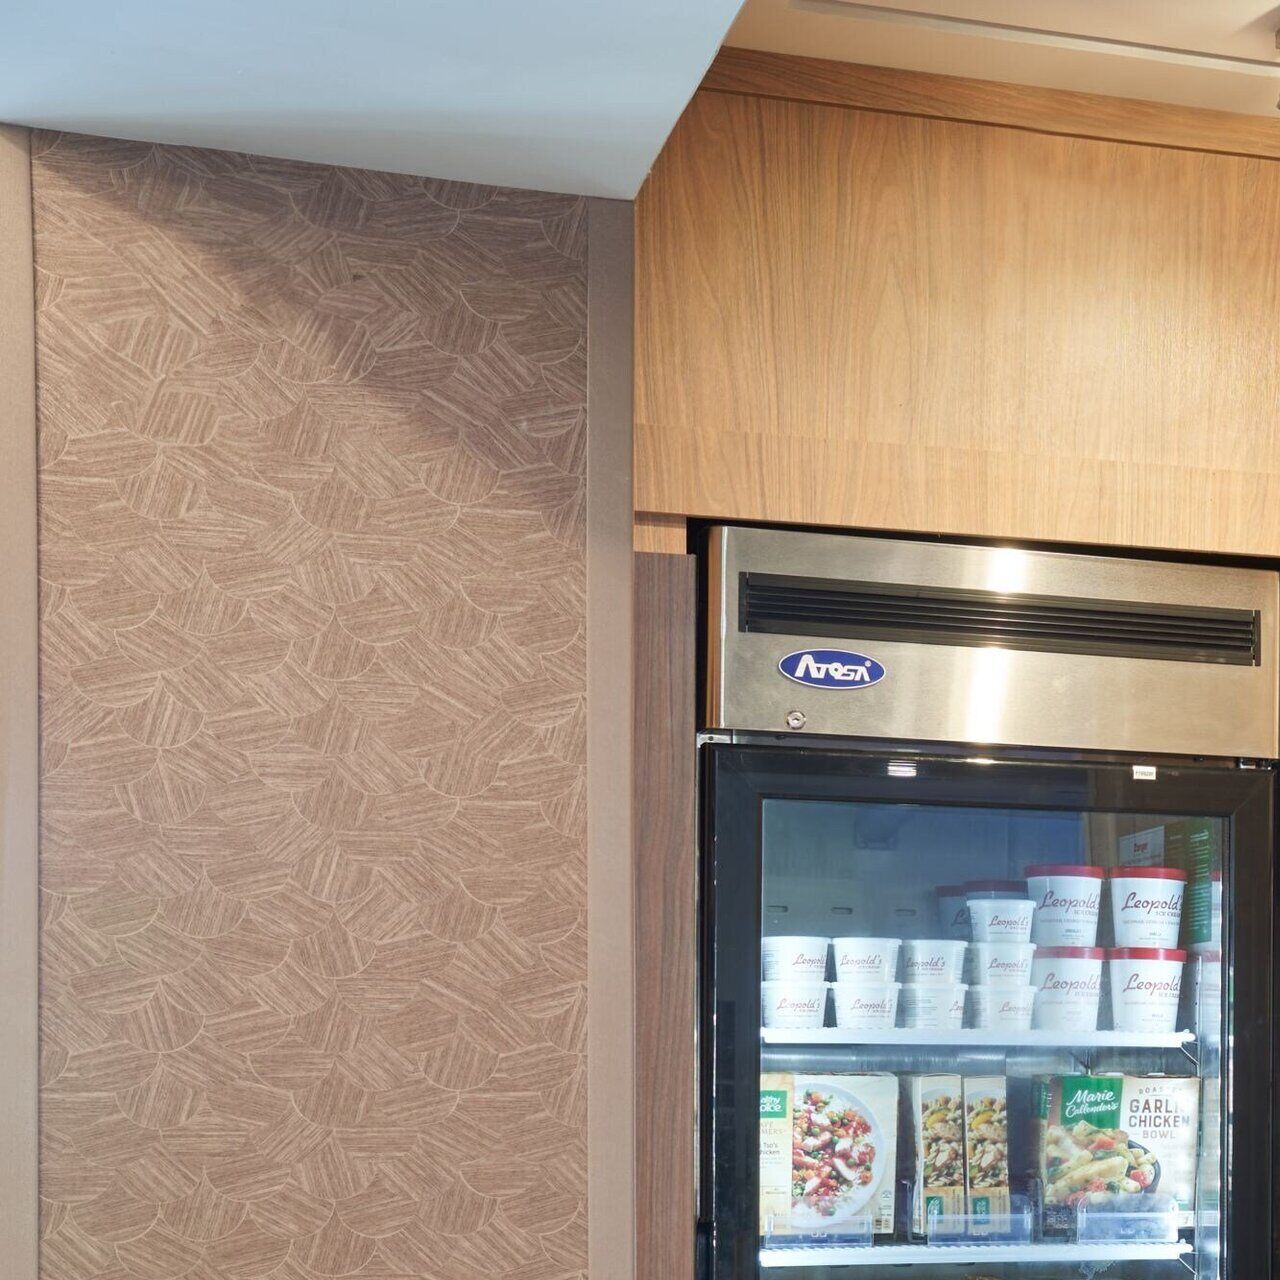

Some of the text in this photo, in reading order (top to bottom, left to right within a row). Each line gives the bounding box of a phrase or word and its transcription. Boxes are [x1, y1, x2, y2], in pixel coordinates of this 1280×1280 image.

[1066, 1090, 1115, 1106] Marie
[1066, 1102, 1118, 1118] Callender's
[1129, 1099, 1183, 1113] GARL
[1129, 1115, 1190, 1127] CHICKEN
[1143, 1130, 1175, 1138] BOWL
